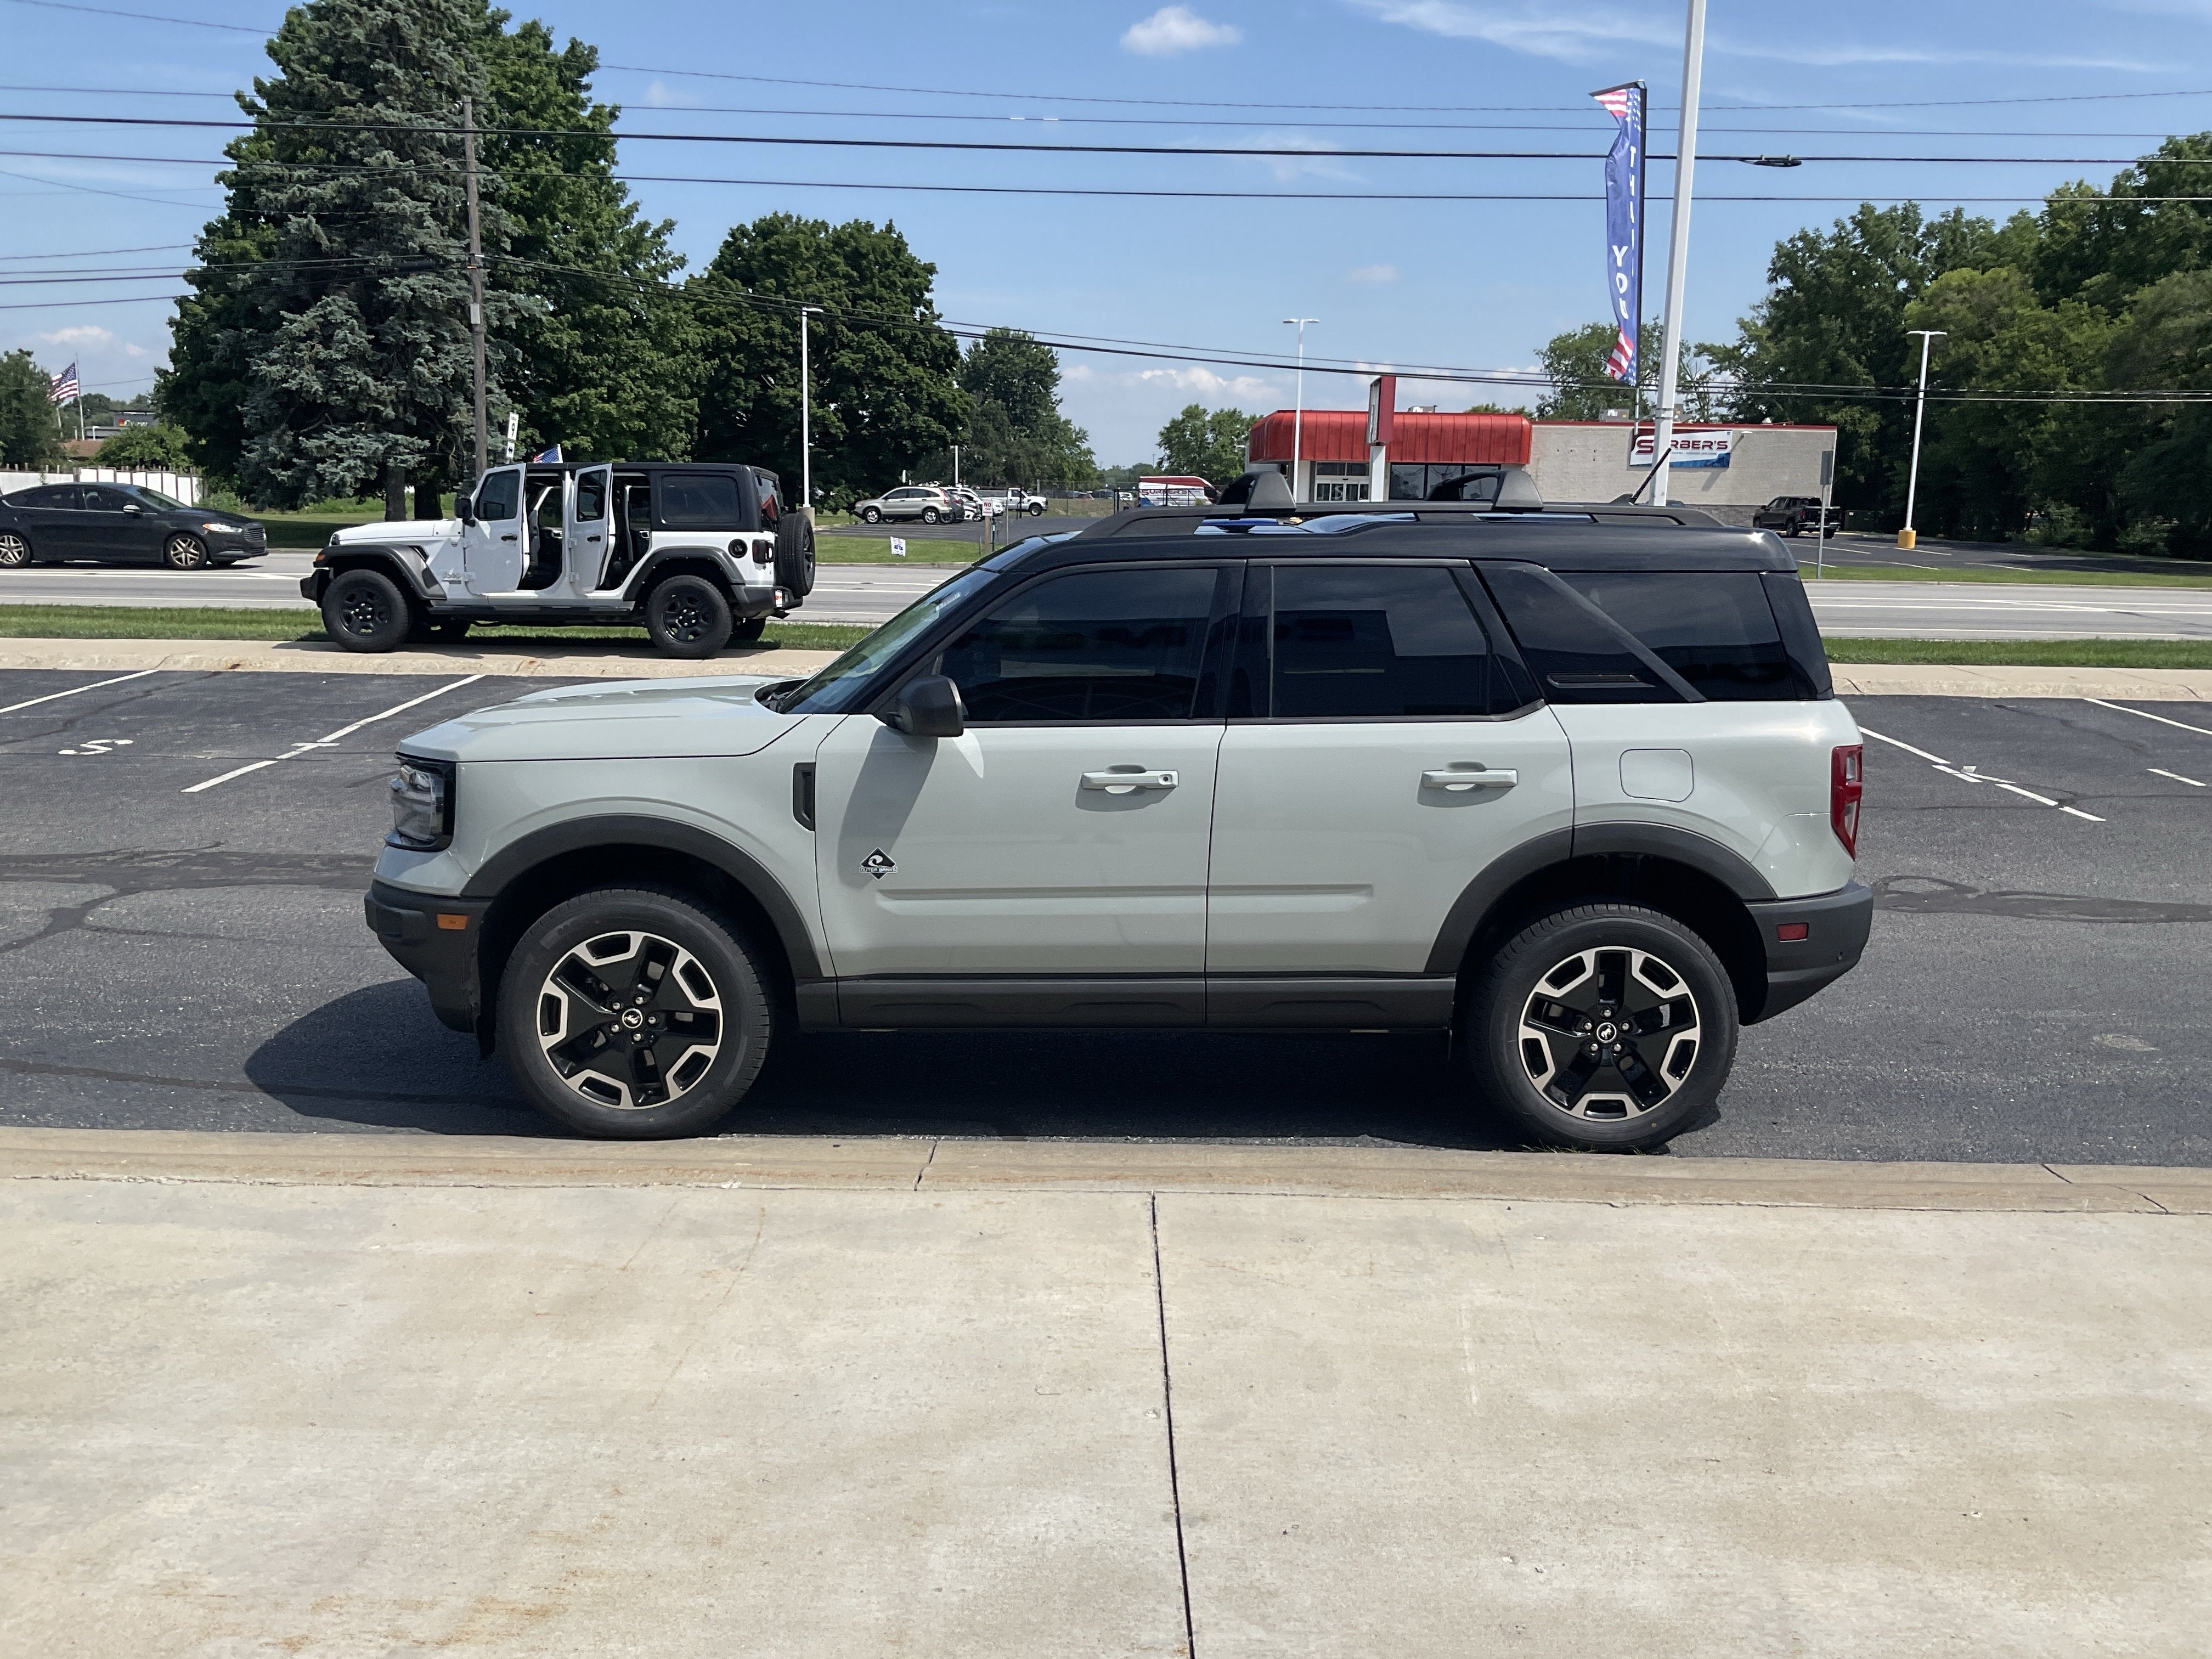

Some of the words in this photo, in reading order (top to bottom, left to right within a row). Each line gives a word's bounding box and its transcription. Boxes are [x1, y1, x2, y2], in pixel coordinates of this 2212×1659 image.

[1612, 245, 1629, 319] YOU
[511, 422, 516, 437] 9
[1635, 439, 1728, 454] SRBER'S
